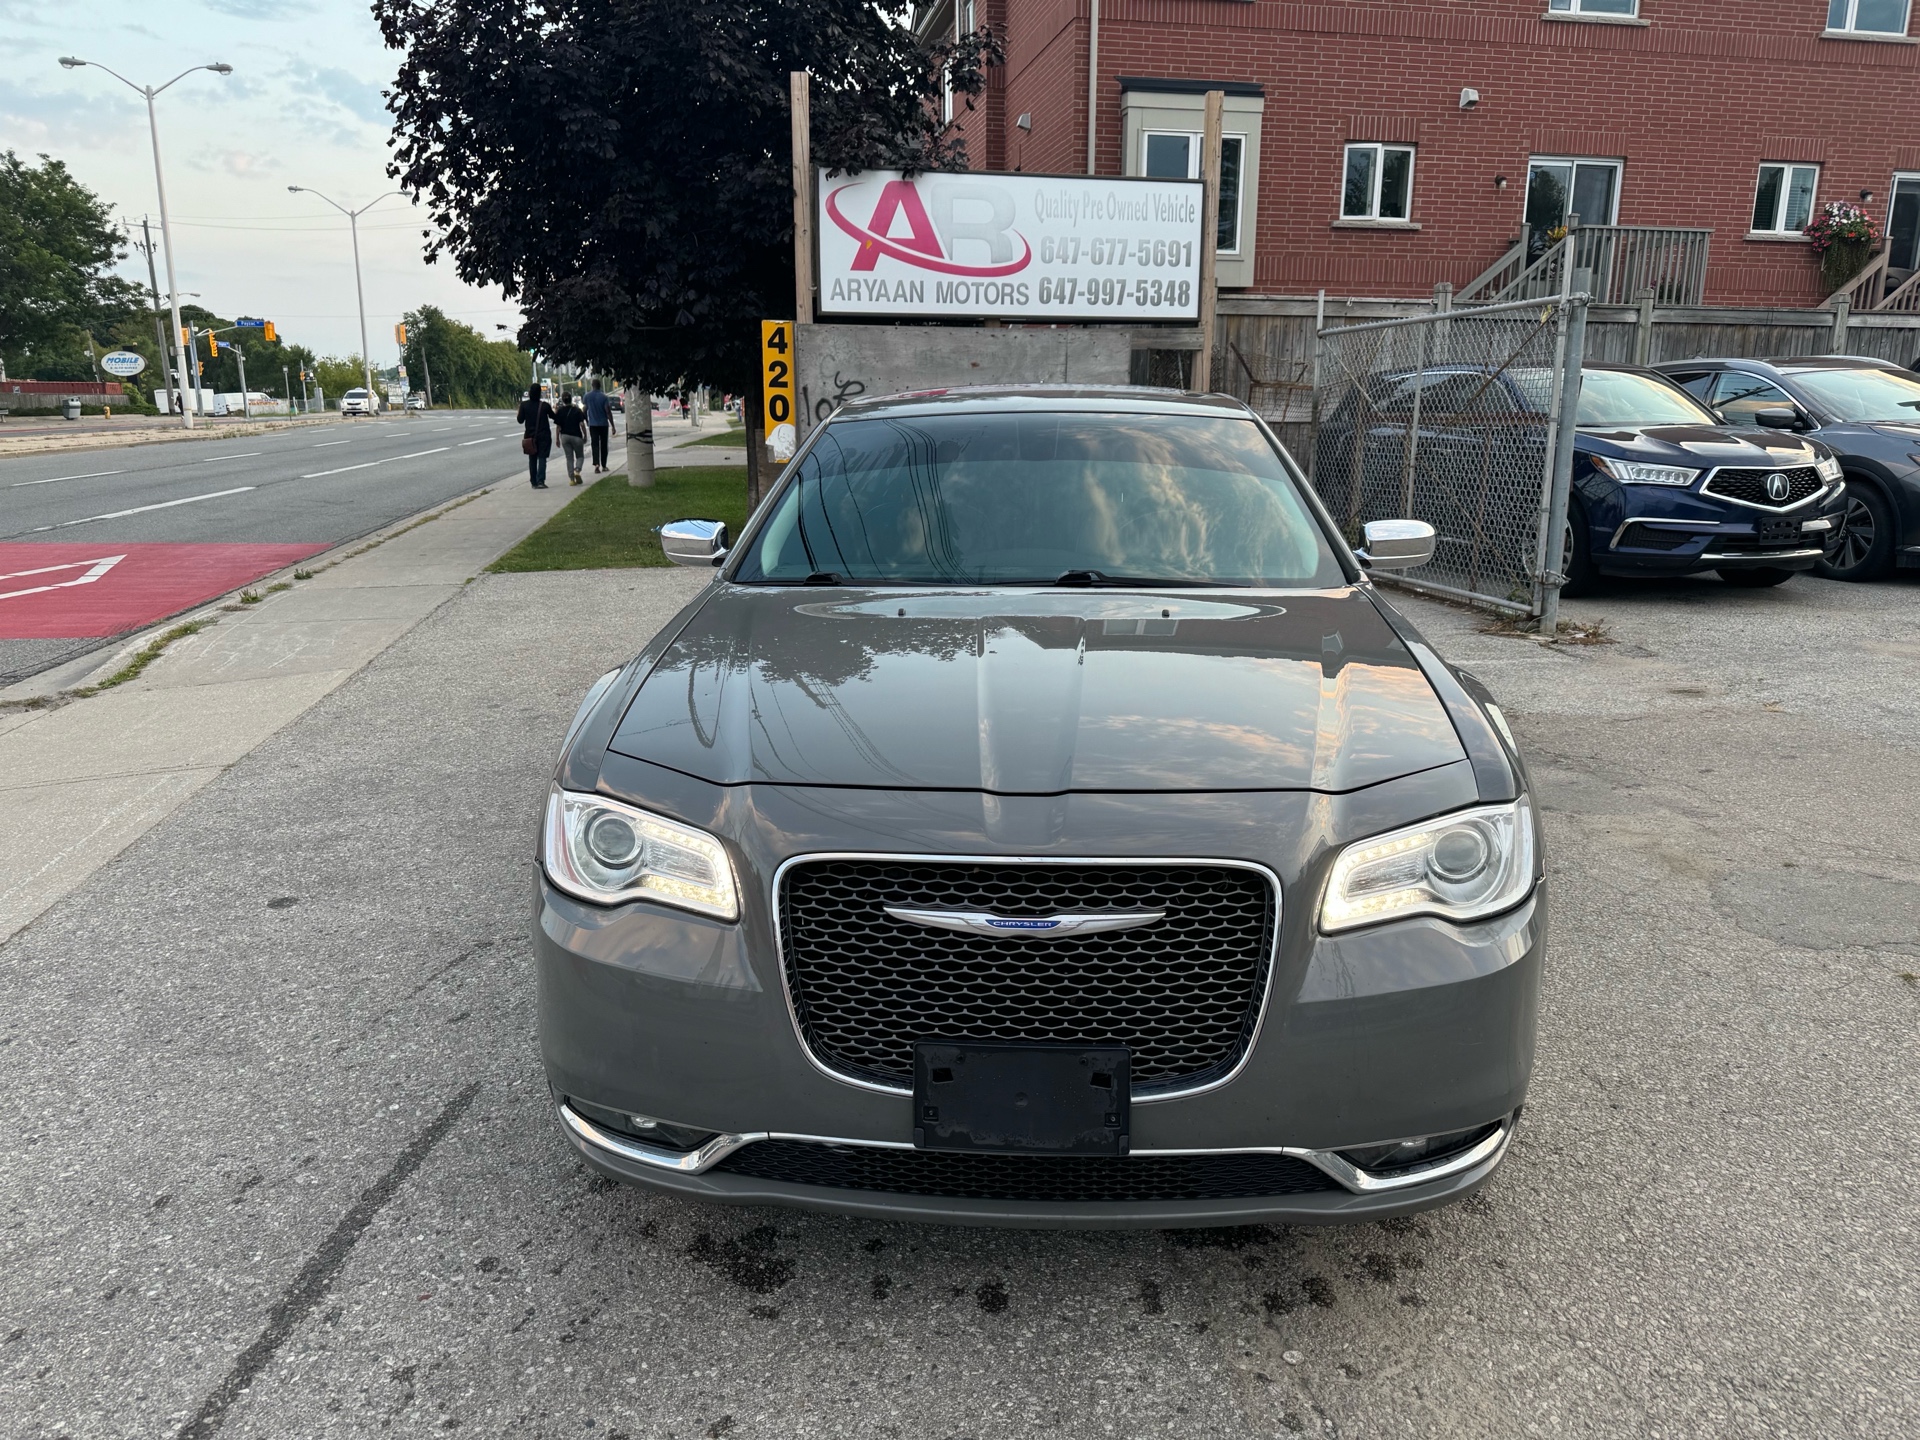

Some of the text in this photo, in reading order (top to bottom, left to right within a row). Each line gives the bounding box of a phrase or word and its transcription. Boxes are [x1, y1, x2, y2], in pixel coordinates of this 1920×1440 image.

[1034, 189, 1195, 227] Quality Pre Owned Vehicle
[850, 180, 1016, 272] AR
[1040, 236, 1192, 268] 647-677-5691
[830, 278, 1030, 306] ARYAAN MOTORS
[1038, 277, 1191, 307] 647-997-5348
